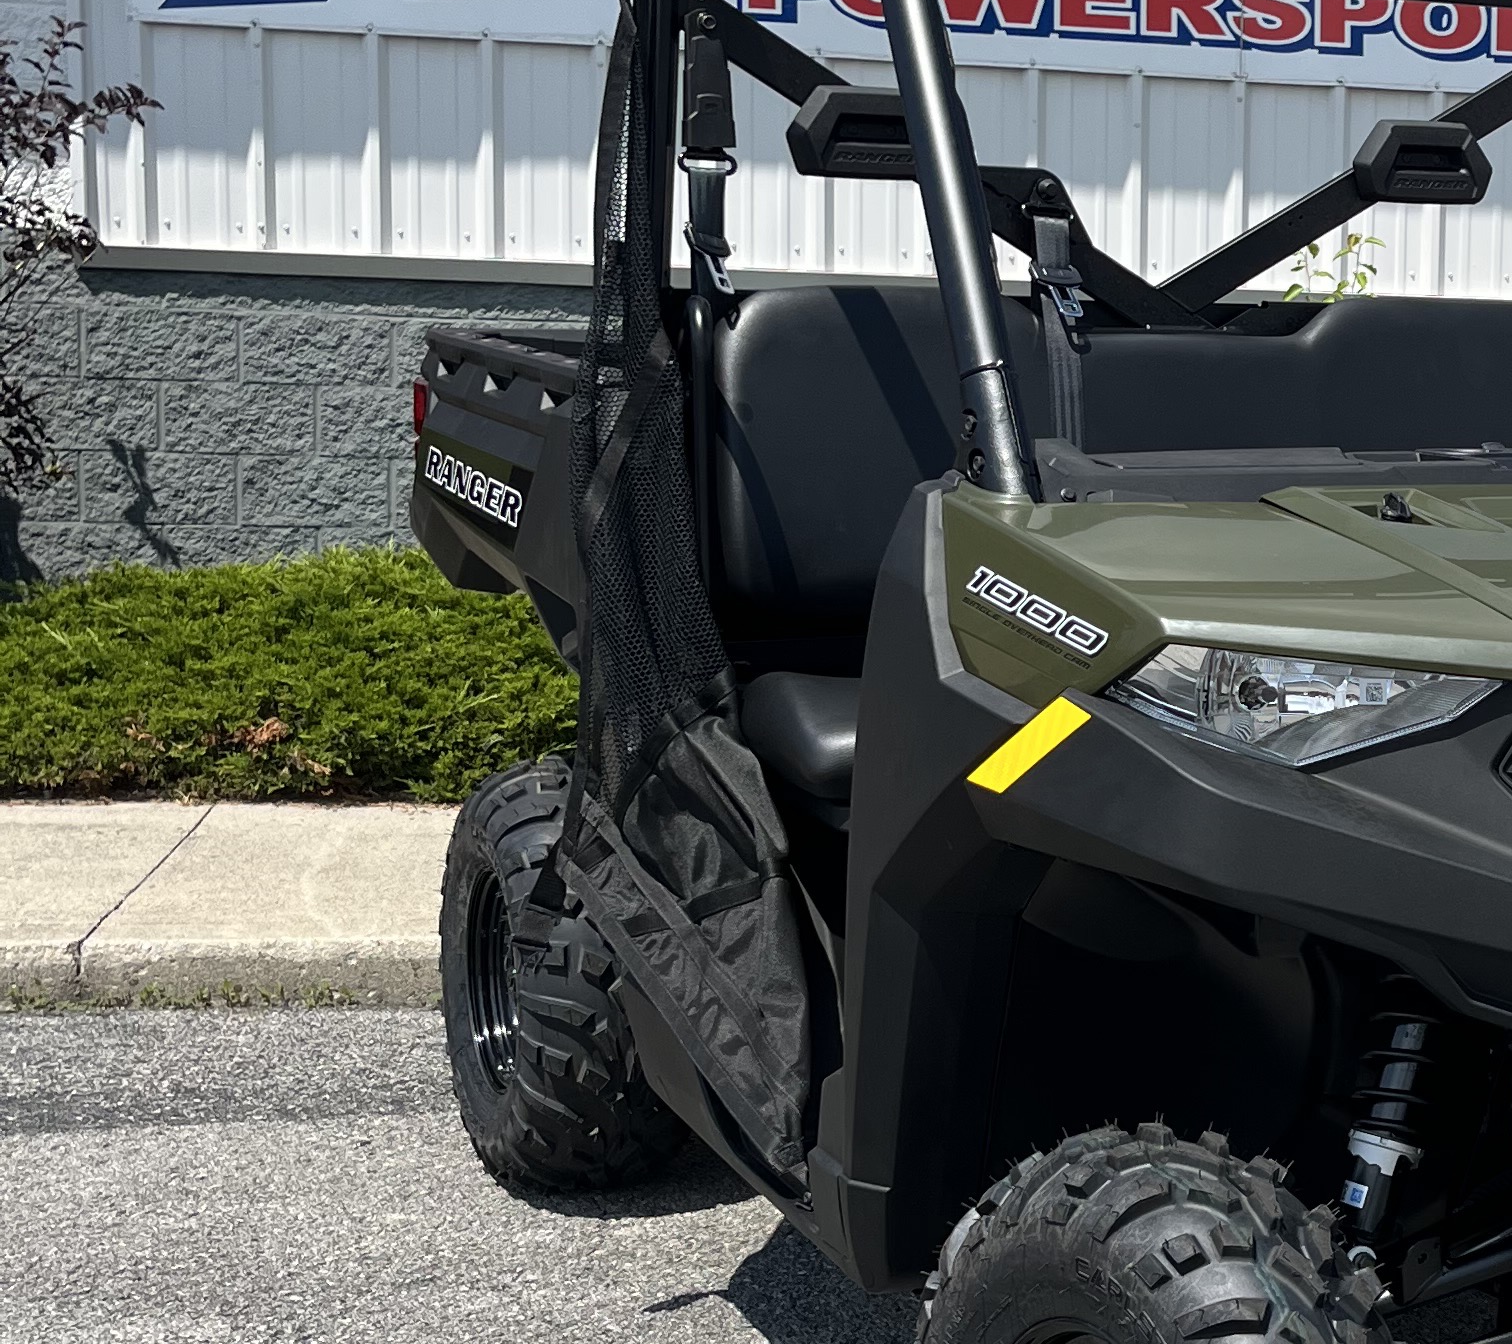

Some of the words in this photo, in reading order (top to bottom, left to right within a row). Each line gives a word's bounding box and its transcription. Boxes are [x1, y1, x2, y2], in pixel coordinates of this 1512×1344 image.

[425, 445, 523, 528] RANGER
[962, 596, 1001, 621] SINGLE
[1003, 619, 1063, 655] OVERHEAD
[1063, 652, 1092, 670] CAM
[966, 564, 1109, 658] 1000
